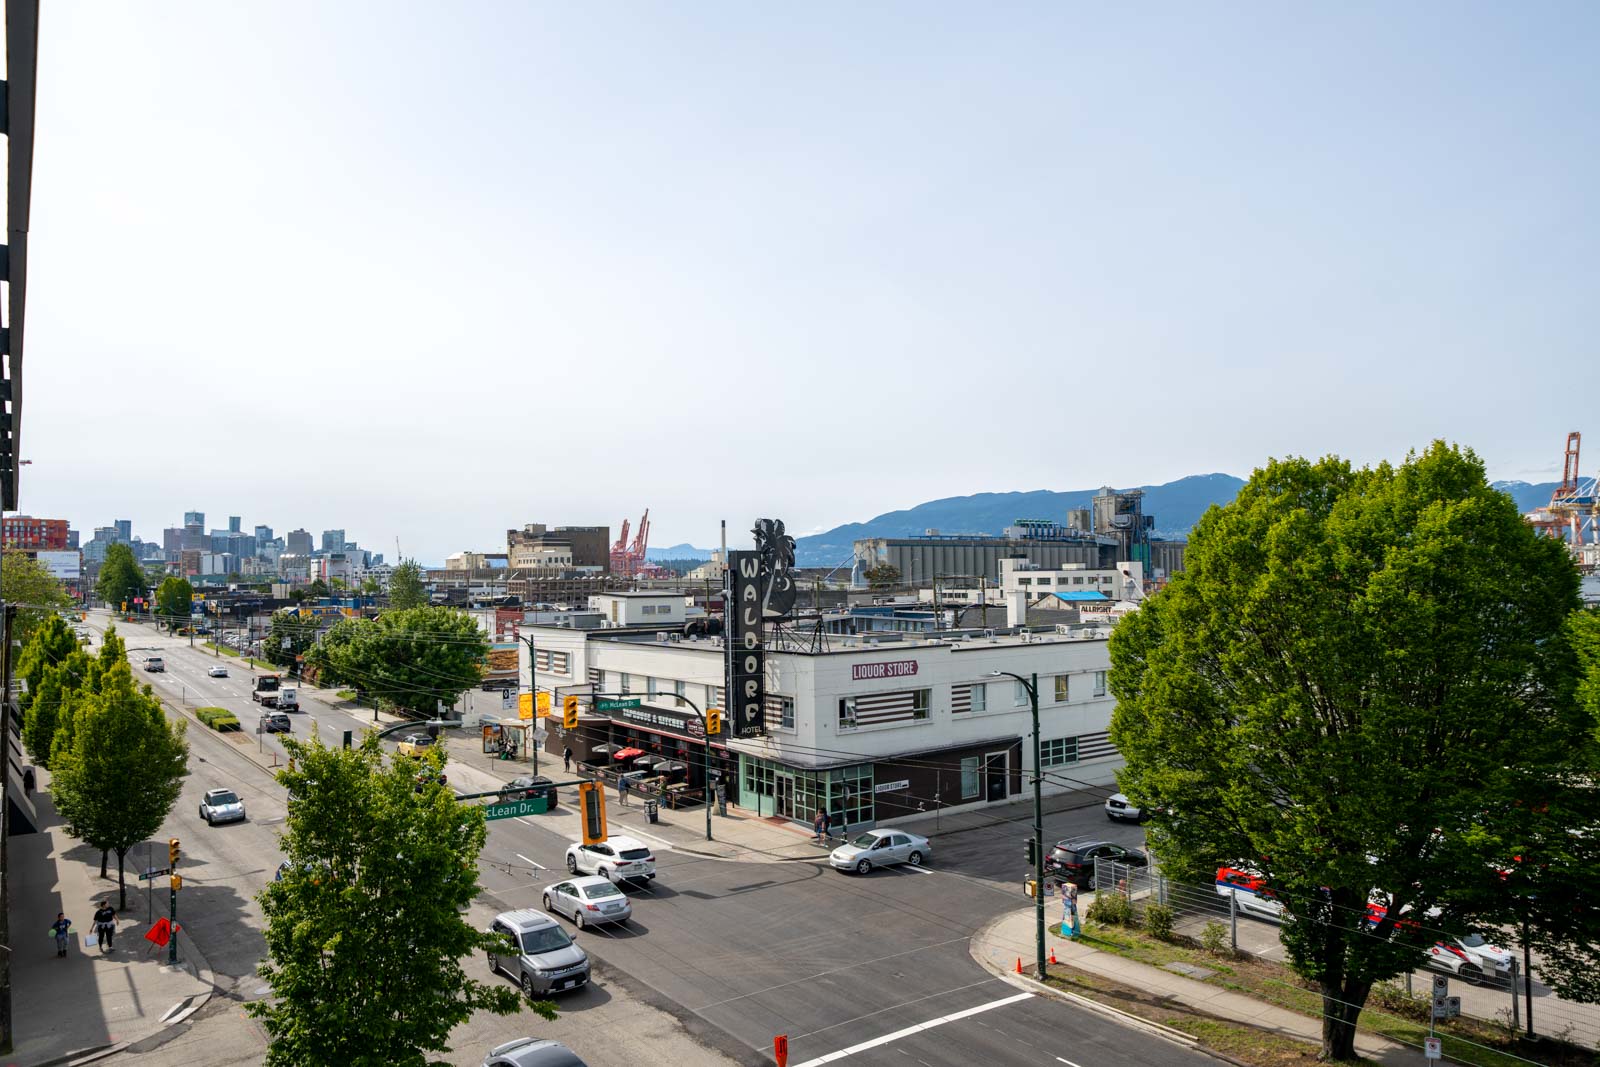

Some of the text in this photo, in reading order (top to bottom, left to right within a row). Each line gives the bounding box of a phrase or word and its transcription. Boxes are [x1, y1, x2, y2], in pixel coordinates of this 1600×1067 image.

[740, 557, 759, 722] WALDORF
[853, 661, 915, 679] LIQUOR STORE
[741, 726, 763, 735] HOTEL
[486, 802, 534, 818] cLean Dr.
